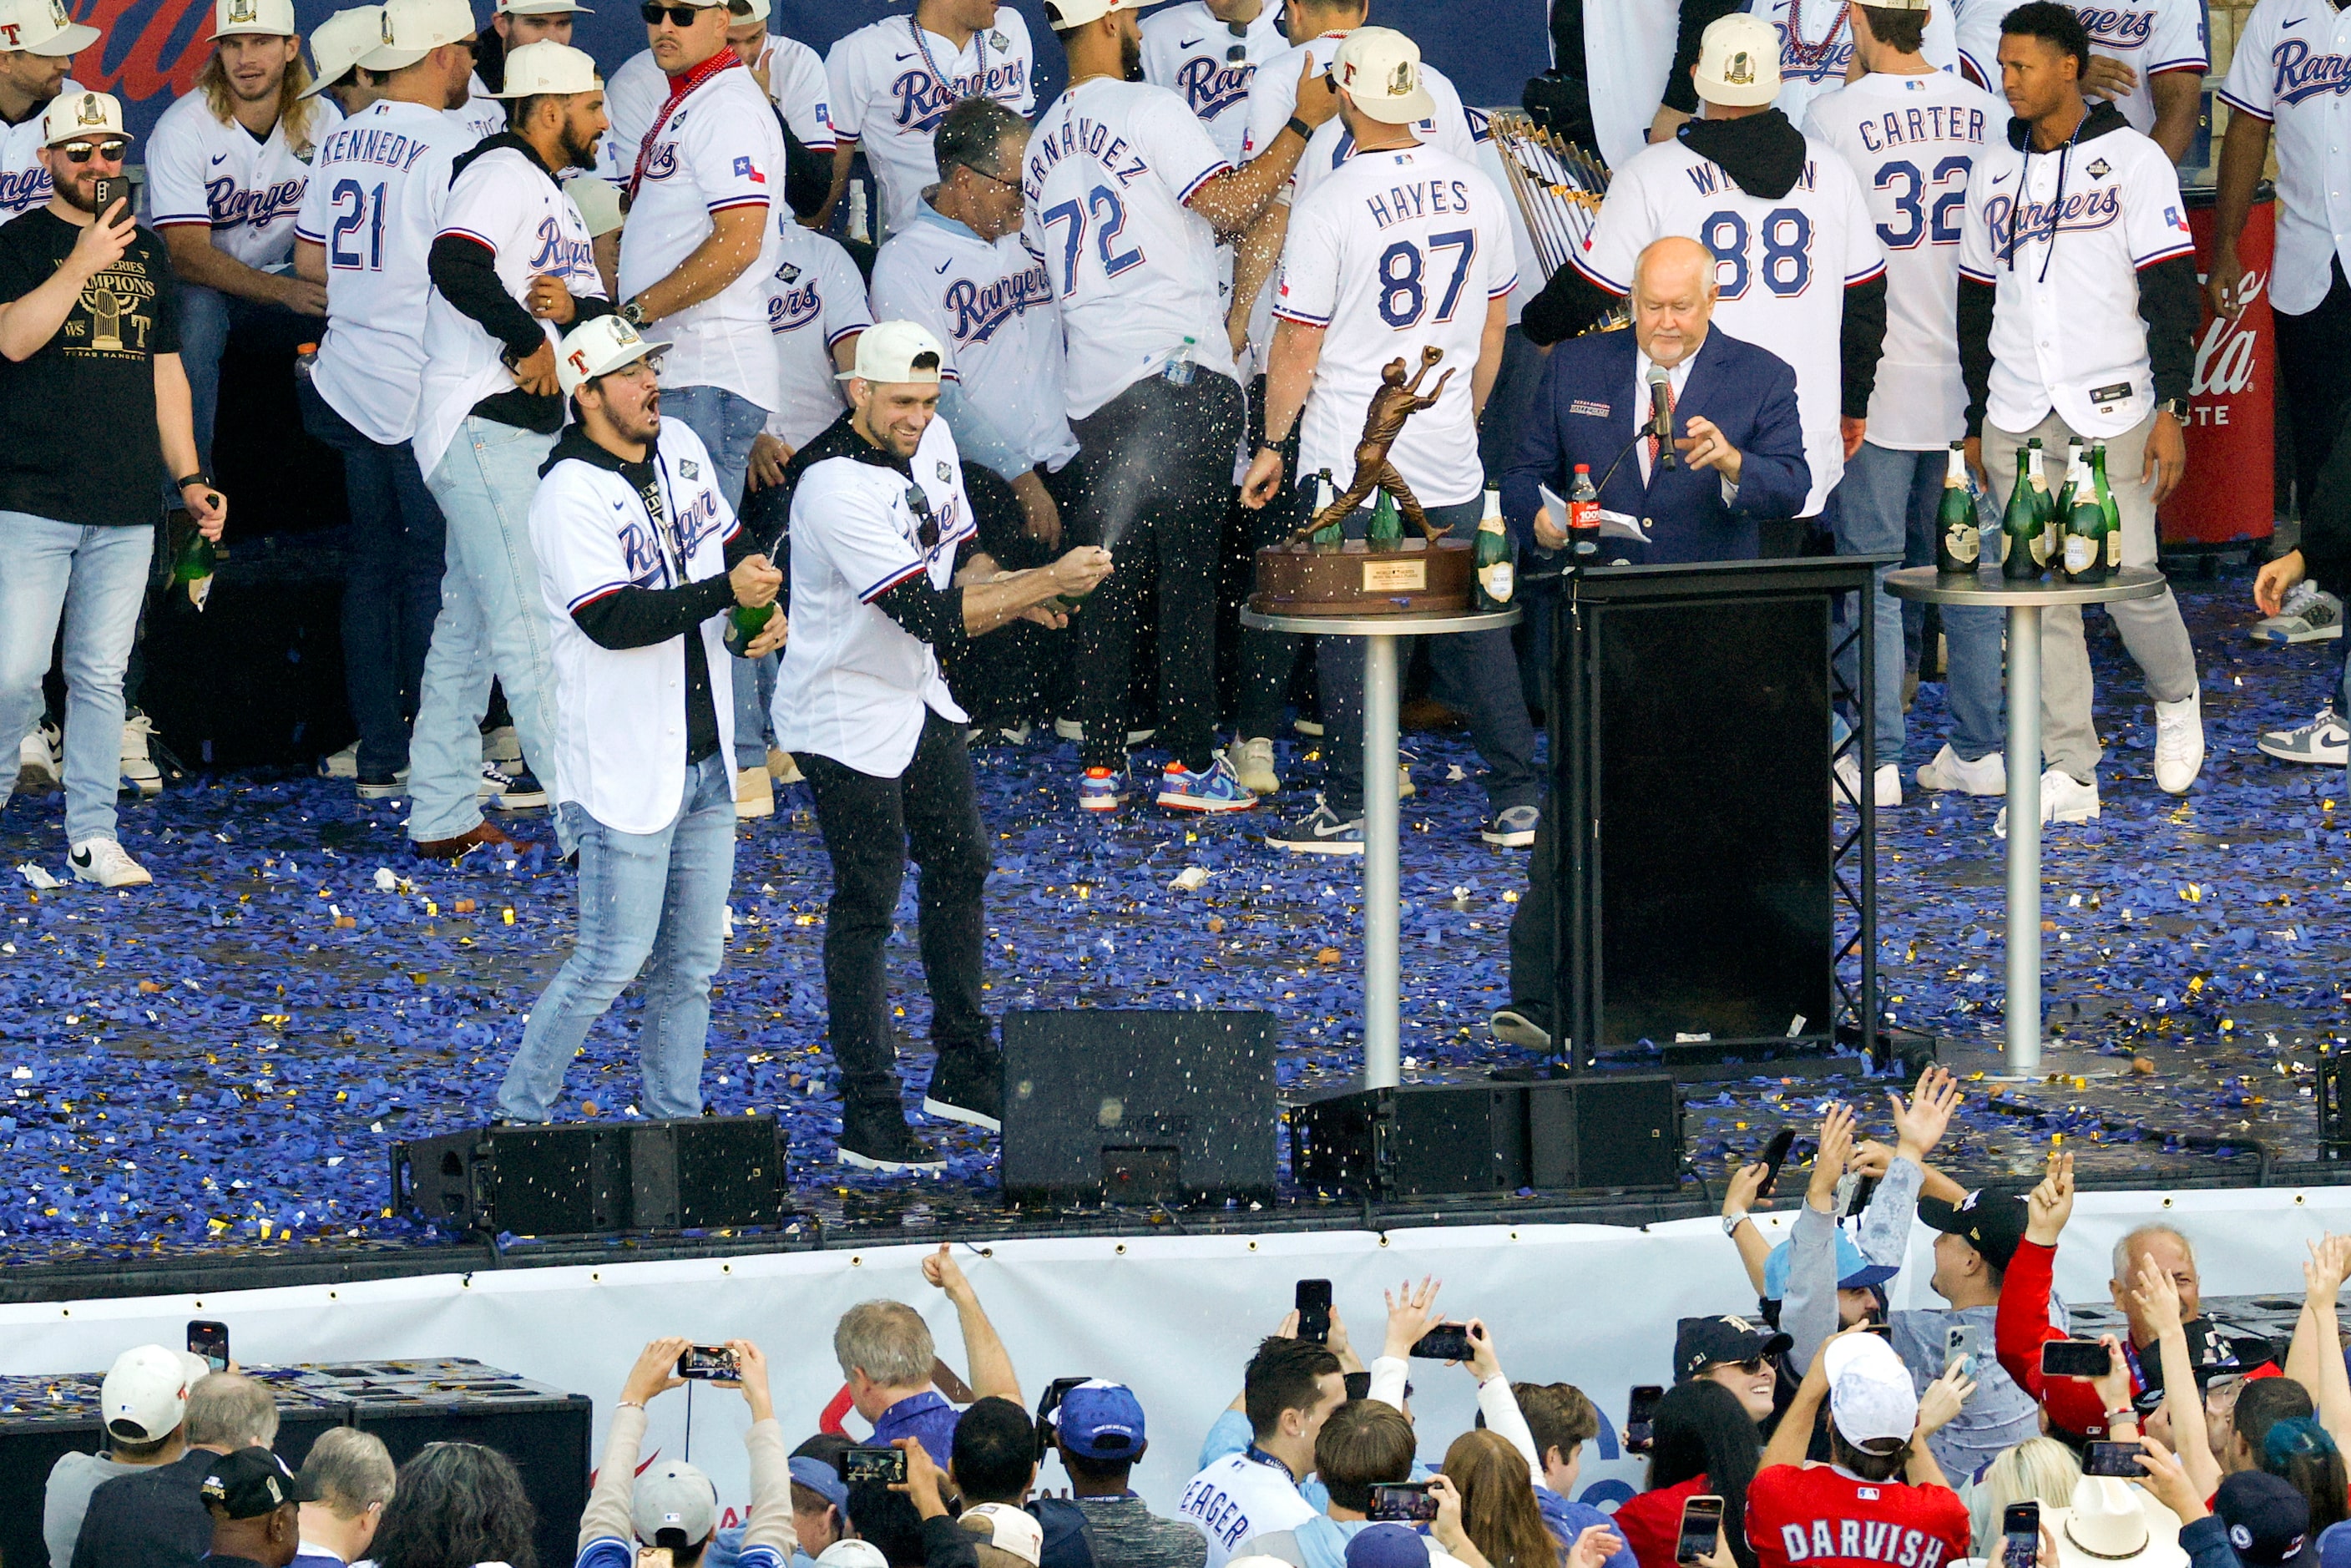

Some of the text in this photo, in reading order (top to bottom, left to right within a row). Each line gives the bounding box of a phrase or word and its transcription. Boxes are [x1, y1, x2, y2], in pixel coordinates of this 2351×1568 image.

[1, 23, 21, 45] T
[2075, 7, 2157, 50] gers
[1343, 61, 1356, 86] T
[321, 129, 430, 173] KENNEDY
[1025, 105, 1150, 203] ERNÁNDEZ
[1858, 106, 1986, 154] CARTER
[204, 175, 310, 232] Range
[331, 178, 388, 271] 21
[1366, 180, 1468, 231] HAYES
[1873, 155, 1973, 250] 32
[1983, 184, 2123, 265] Rangers
[1042, 184, 1146, 300] 72
[1700, 208, 1815, 301] 88
[1378, 228, 1477, 331] 87
[131, 314, 150, 347] T
[568, 349, 589, 376] T
[1179, 1480, 1249, 1552] EAGER
[1780, 1518, 1944, 1568] DARVISH
